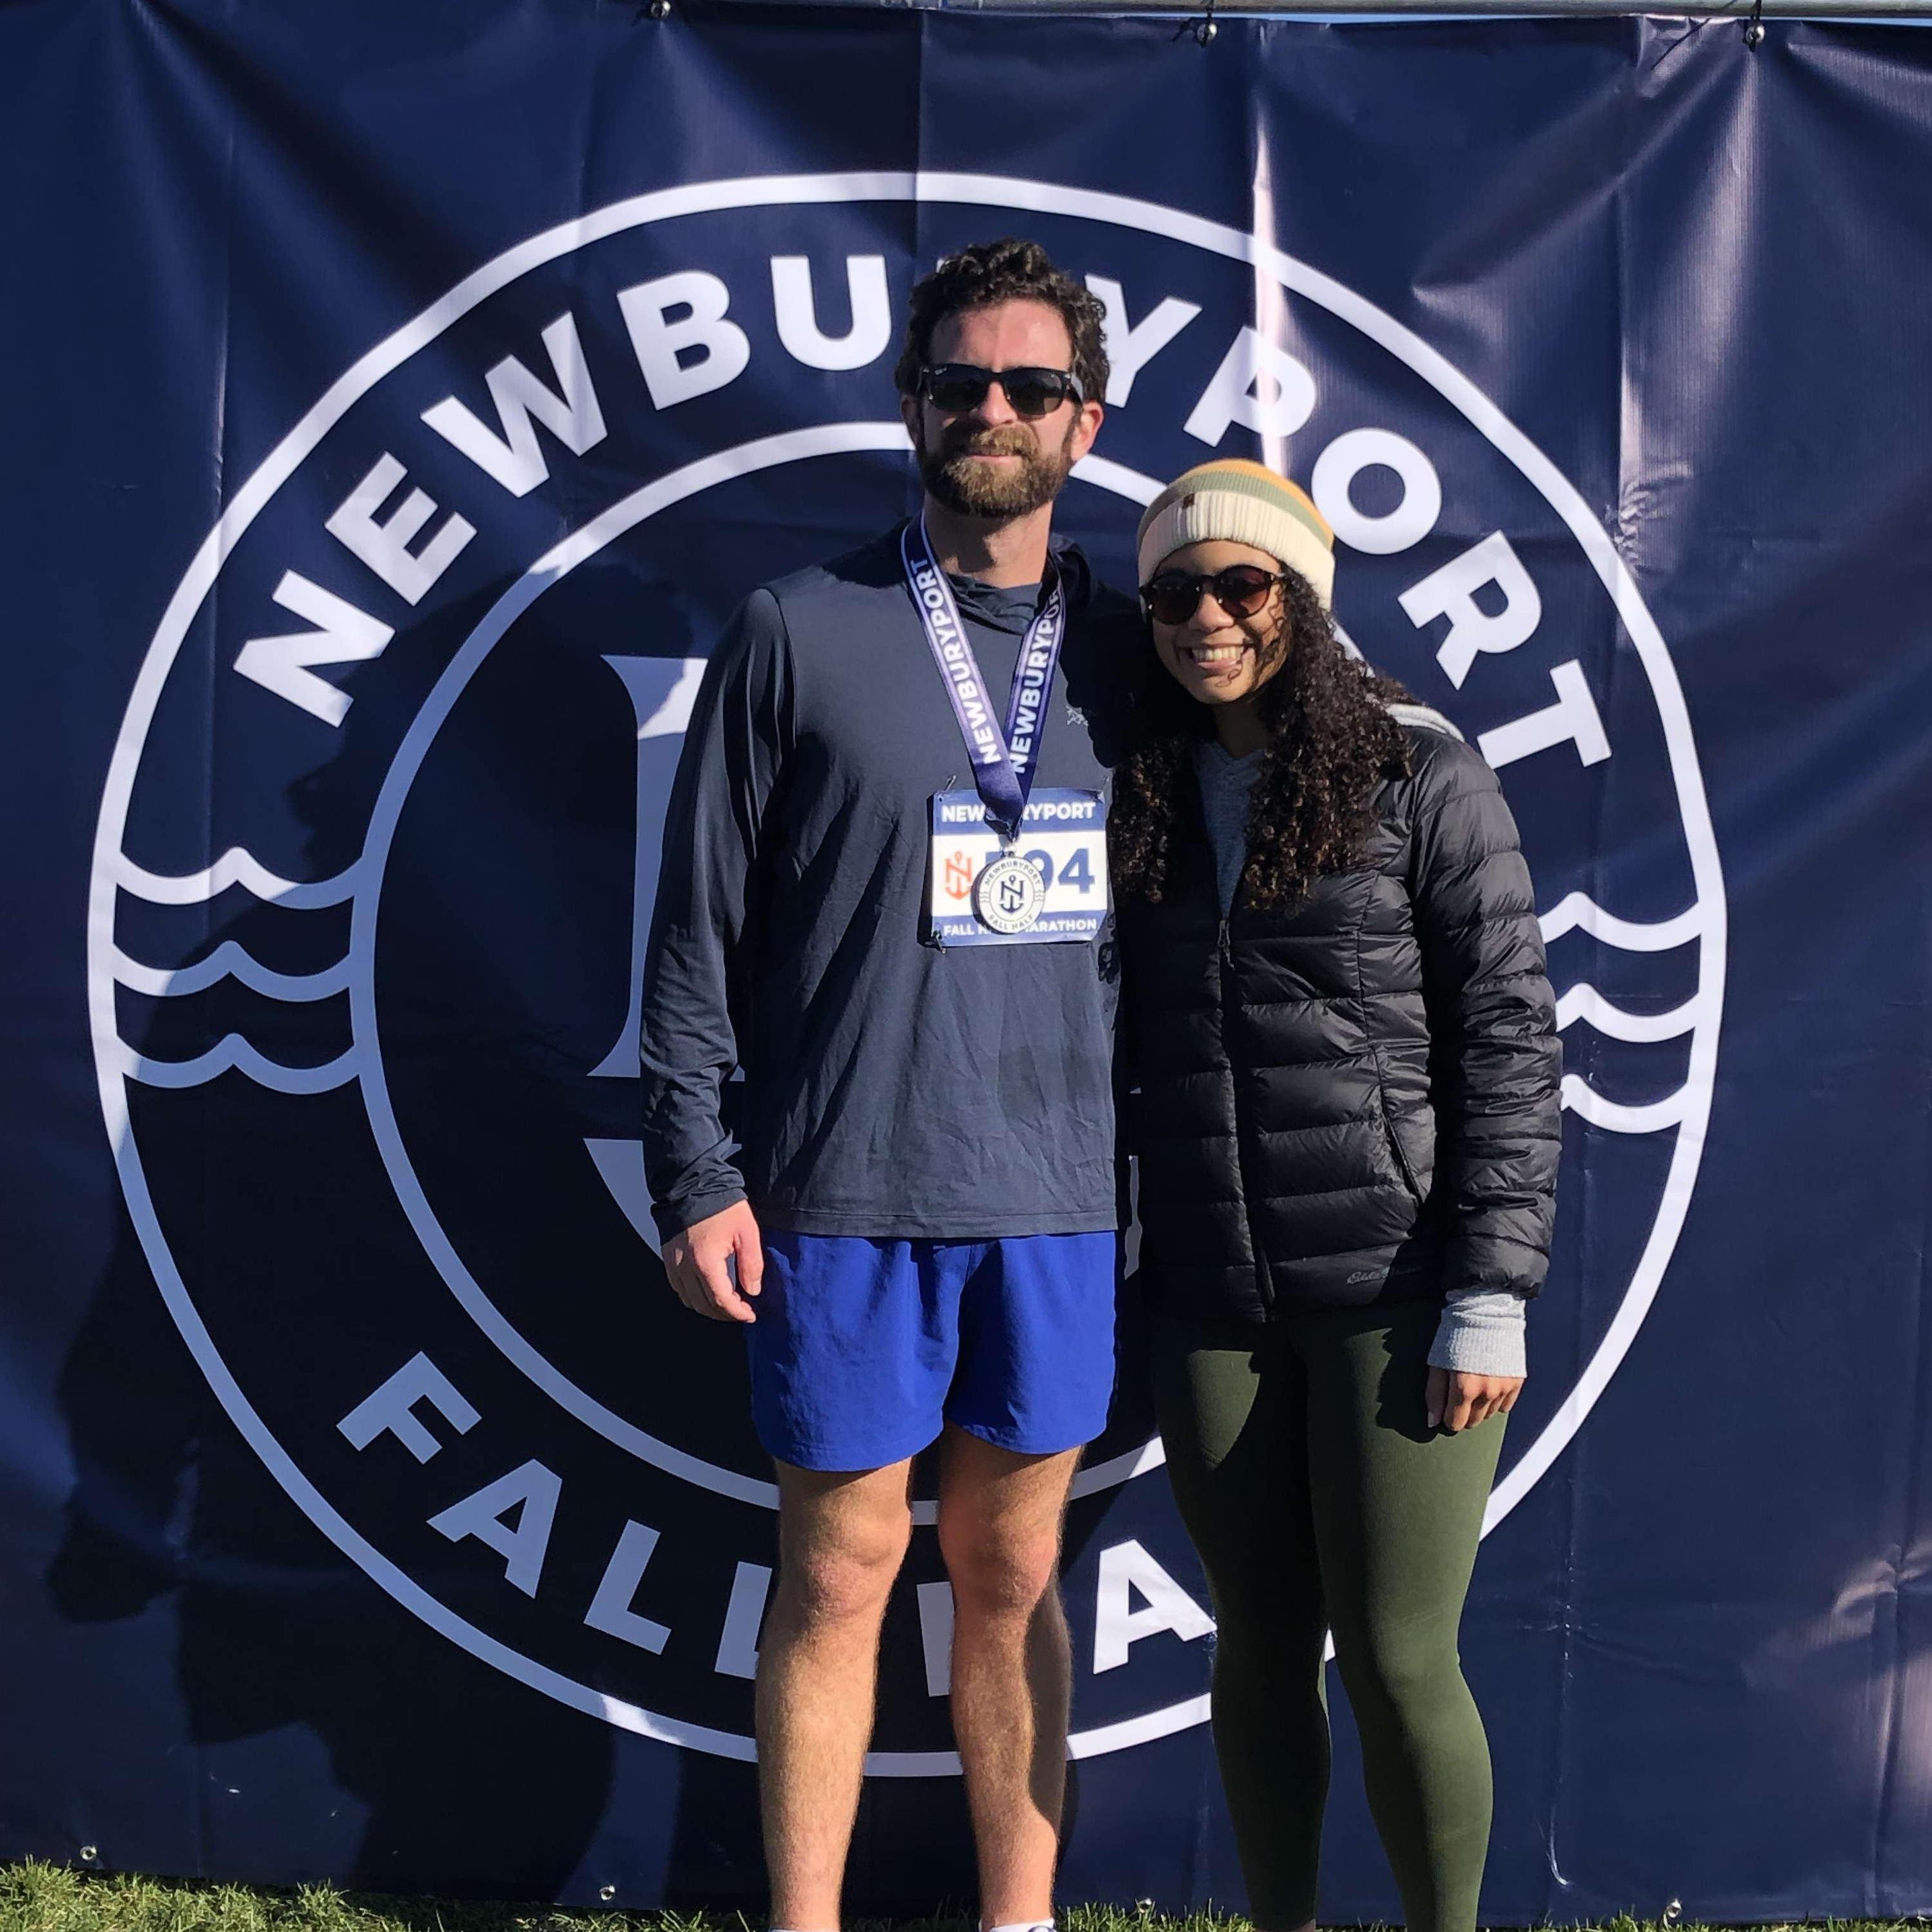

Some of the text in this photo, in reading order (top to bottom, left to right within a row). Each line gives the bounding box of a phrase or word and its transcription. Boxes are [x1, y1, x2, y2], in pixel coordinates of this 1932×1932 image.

[233, 255, 1612, 770] NEWBUYPORT
[910, 559, 1002, 765] NEWBURYPORT
[941, 802, 1096, 822] NEWRYPORT
[984, 860, 1040, 885] NEWBURYPORT
[985, 848, 1096, 894] 94
[943, 923, 974, 936] FALL
[1025, 918, 1097, 933] ARATHON
[989, 913, 1034, 930] FALL HALF
